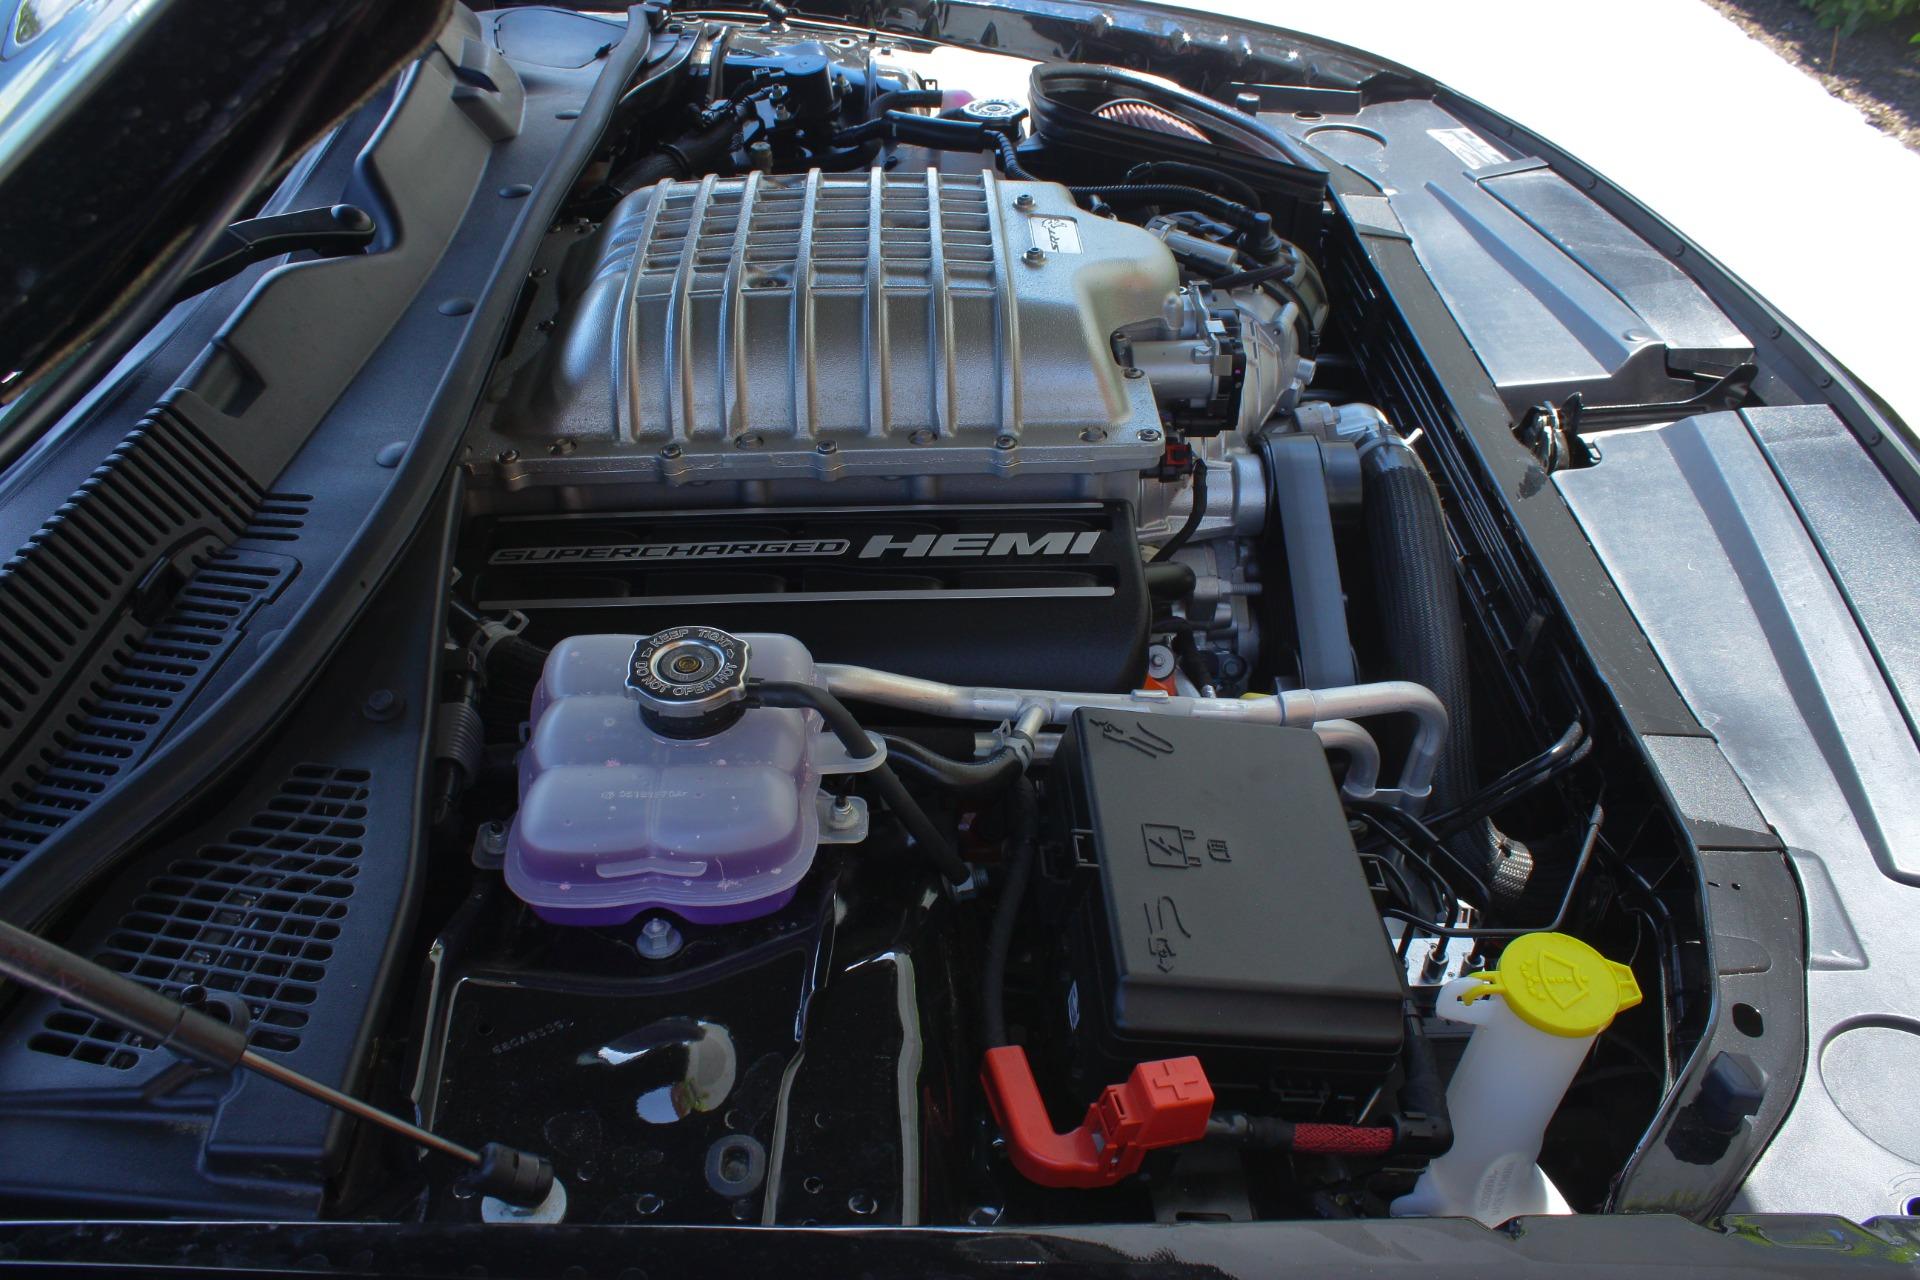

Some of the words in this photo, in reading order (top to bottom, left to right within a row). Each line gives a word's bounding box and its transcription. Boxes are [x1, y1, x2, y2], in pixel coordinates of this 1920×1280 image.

[1047, 227, 1061, 253] SRT
[492, 540, 848, 562] SUPERCHARGED
[858, 531, 1101, 558] HEMI
[650, 629, 689, 648] KEEP
[698, 629, 736, 648] TIGHT
[635, 661, 649, 676] DO
[717, 662, 737, 685] HOT
[641, 677, 671, 693] NOT
[672, 680, 717, 696] OPEN
